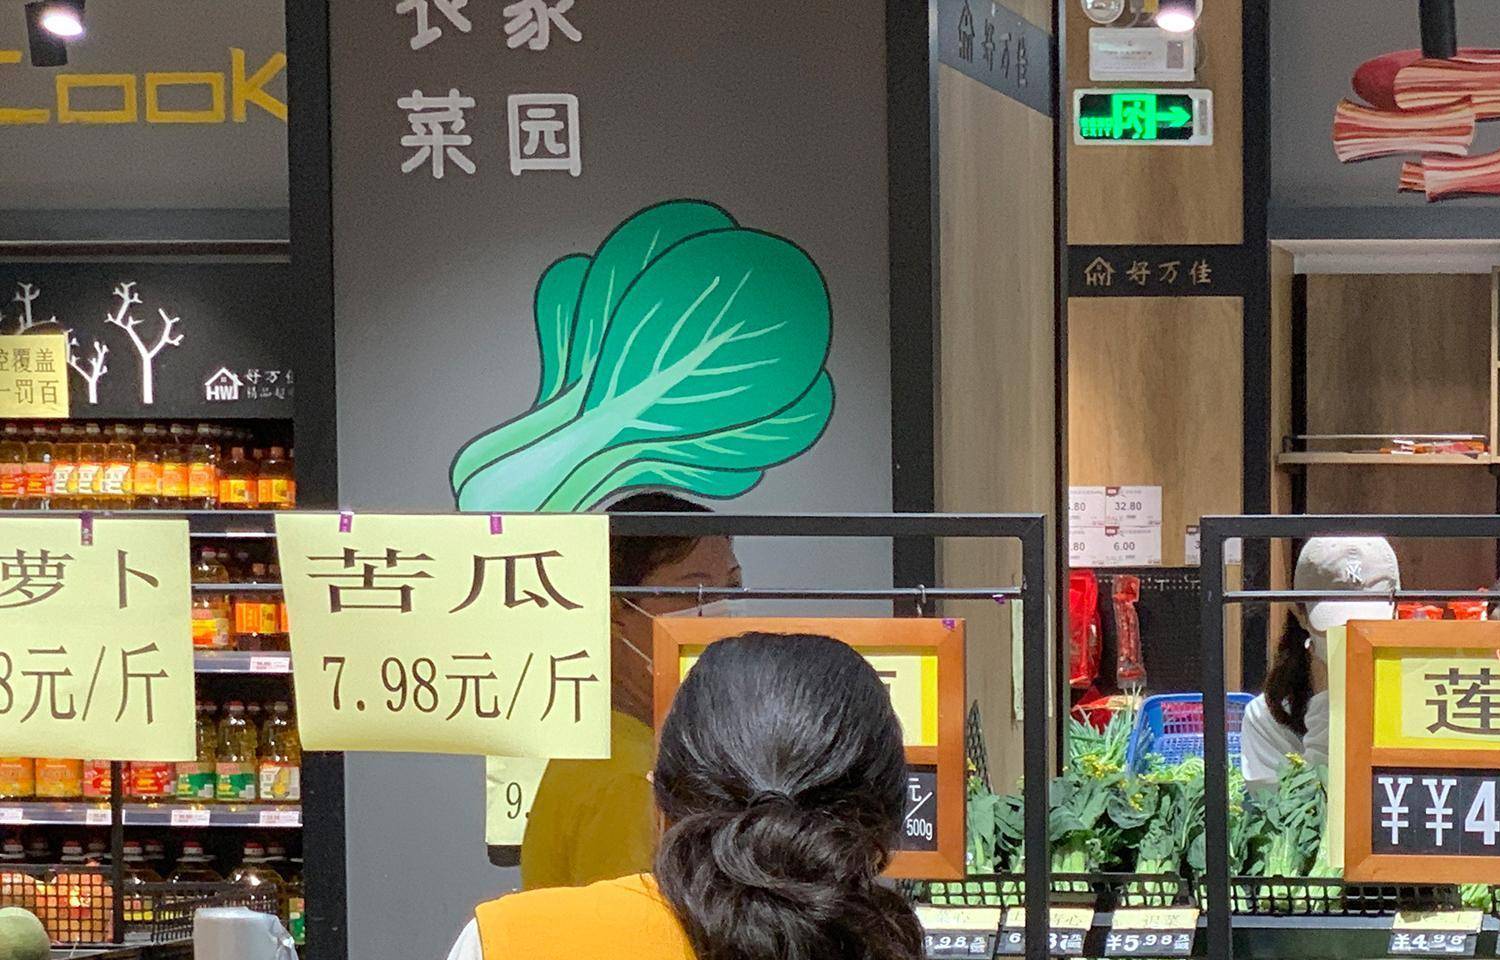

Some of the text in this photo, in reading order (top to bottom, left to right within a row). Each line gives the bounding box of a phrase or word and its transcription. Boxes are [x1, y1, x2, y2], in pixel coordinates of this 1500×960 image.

[397, 88, 581, 179] 菜园
[1126, 259, 1212, 286] 好万佳
[1114, 501, 1143, 512] 32.80
[1113, 541, 1136, 552] 6.00
[0, 548, 160, 610] 萝卜
[307, 547, 584, 614] 苦瓜
[322, 649, 599, 724] 7.98元/斤
